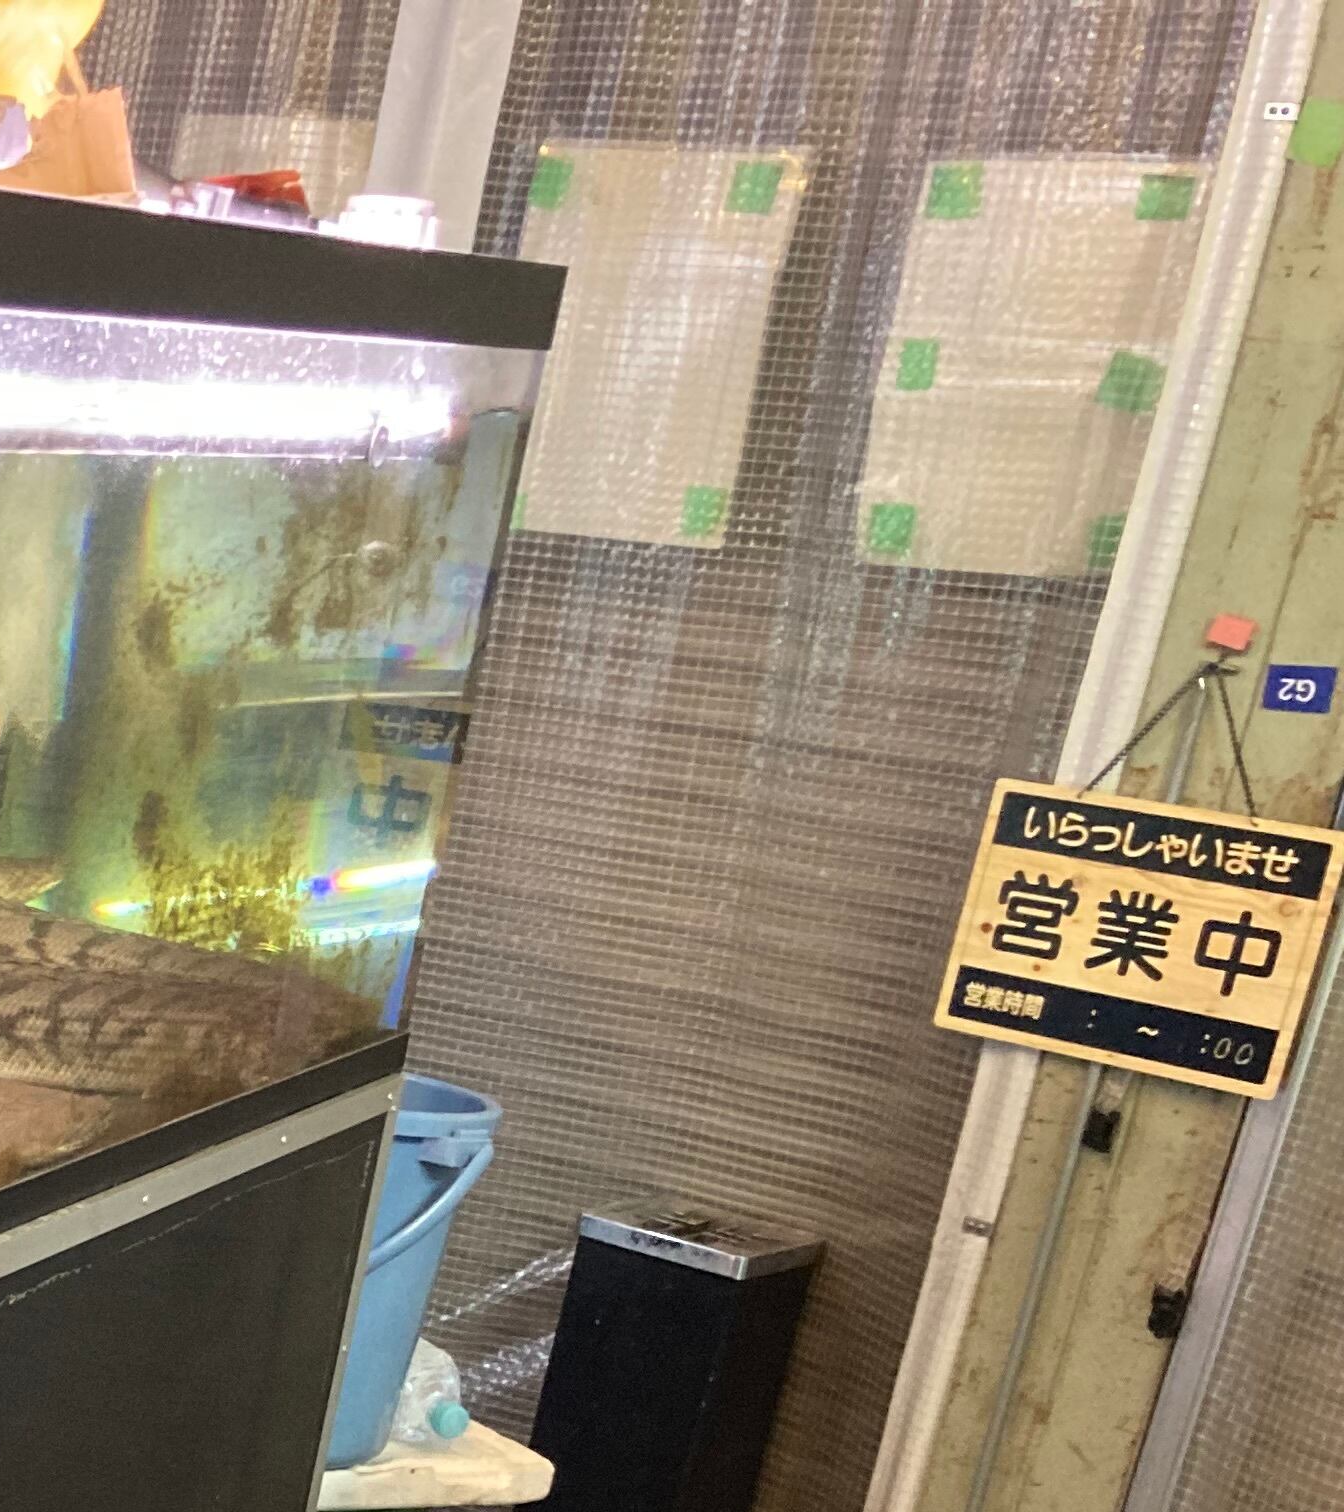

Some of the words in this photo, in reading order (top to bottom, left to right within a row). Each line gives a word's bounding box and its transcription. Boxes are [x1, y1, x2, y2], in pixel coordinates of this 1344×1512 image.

[1277, 677, 1317, 704] G2
[1023, 805, 1300, 883] いらっしゃいませ
[991, 869, 1283, 998] 営業中
[963, 980, 1046, 1021] 営業時間
